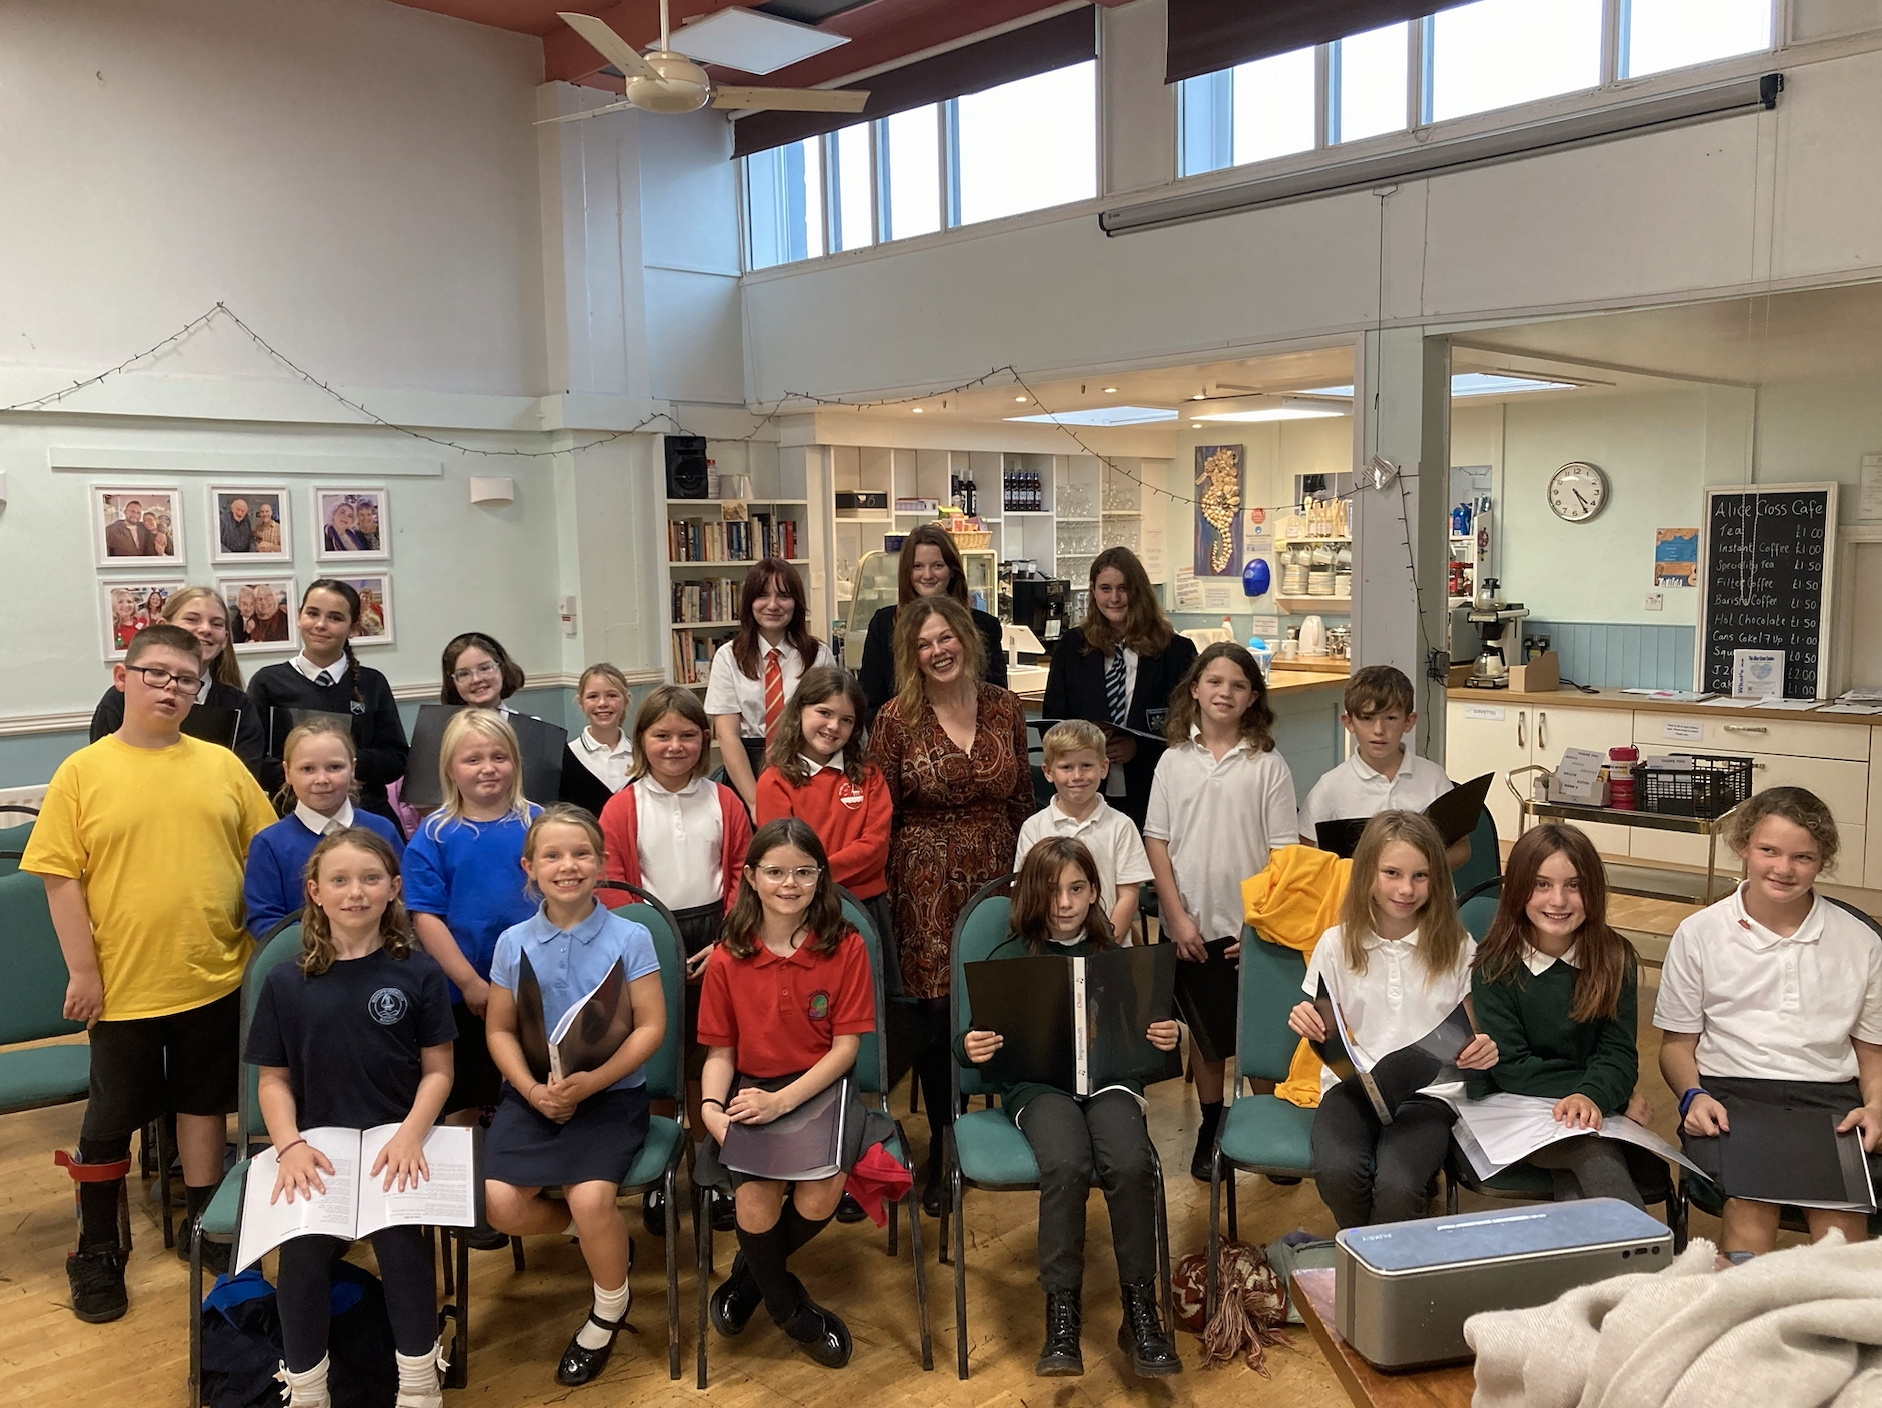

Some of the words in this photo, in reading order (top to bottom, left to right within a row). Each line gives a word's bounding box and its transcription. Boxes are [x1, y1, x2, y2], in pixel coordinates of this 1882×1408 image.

[1715, 502, 1752, 518] Alice
[1757, 500, 1788, 516] Cross
[1792, 500, 1823, 519] Cafe
[1720, 524, 1743, 536] Tea
[1719, 542, 1753, 553] Instant
[1759, 542, 1790, 558] Coffee
[1760, 560, 1774, 569] Tea
[1717, 578, 1745, 589] Filter
[1747, 577, 1773, 592] Coffee
[1750, 594, 1777, 608] Coffee
[1714, 613, 1733, 626] Hot
[1738, 613, 1786, 626] Chocolate
[1712, 630, 1734, 642] Cans
